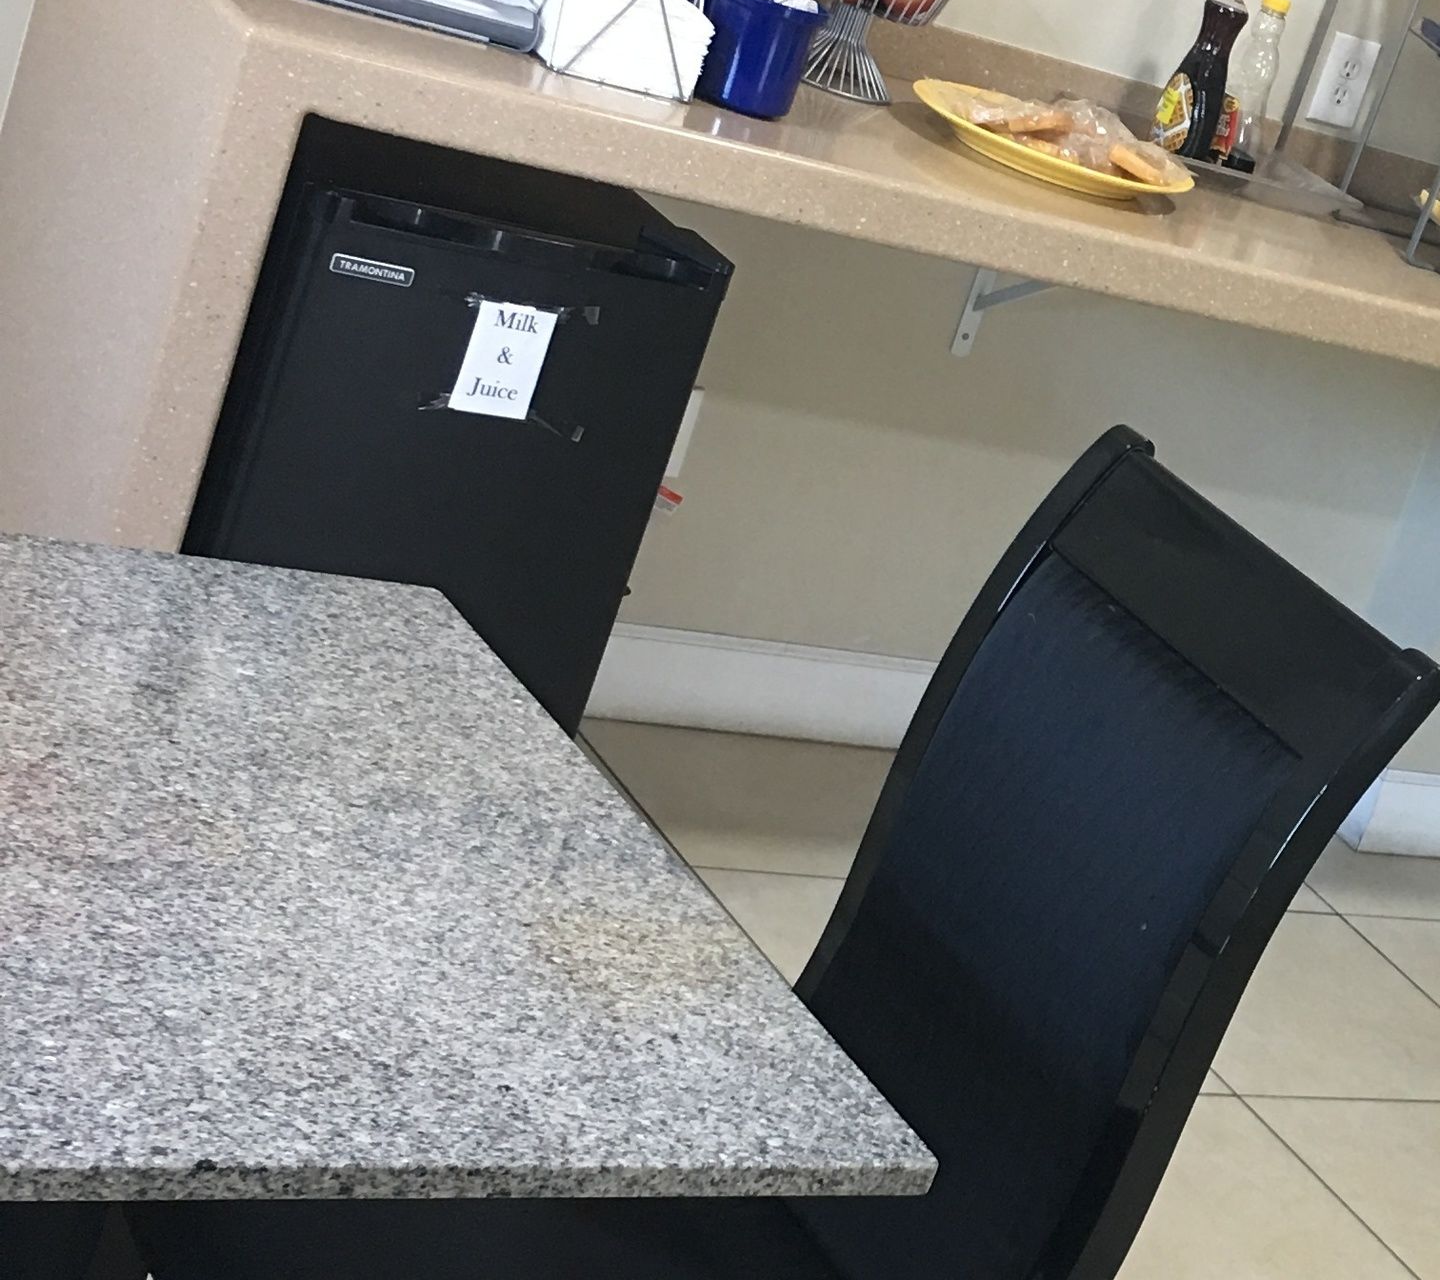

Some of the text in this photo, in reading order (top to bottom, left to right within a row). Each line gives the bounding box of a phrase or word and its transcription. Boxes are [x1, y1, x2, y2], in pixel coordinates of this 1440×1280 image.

[340, 259, 405, 282] TRAMONTINA
[494, 310, 538, 334] Milk
[496, 347, 514, 365] &
[466, 377, 518, 401] Juice
